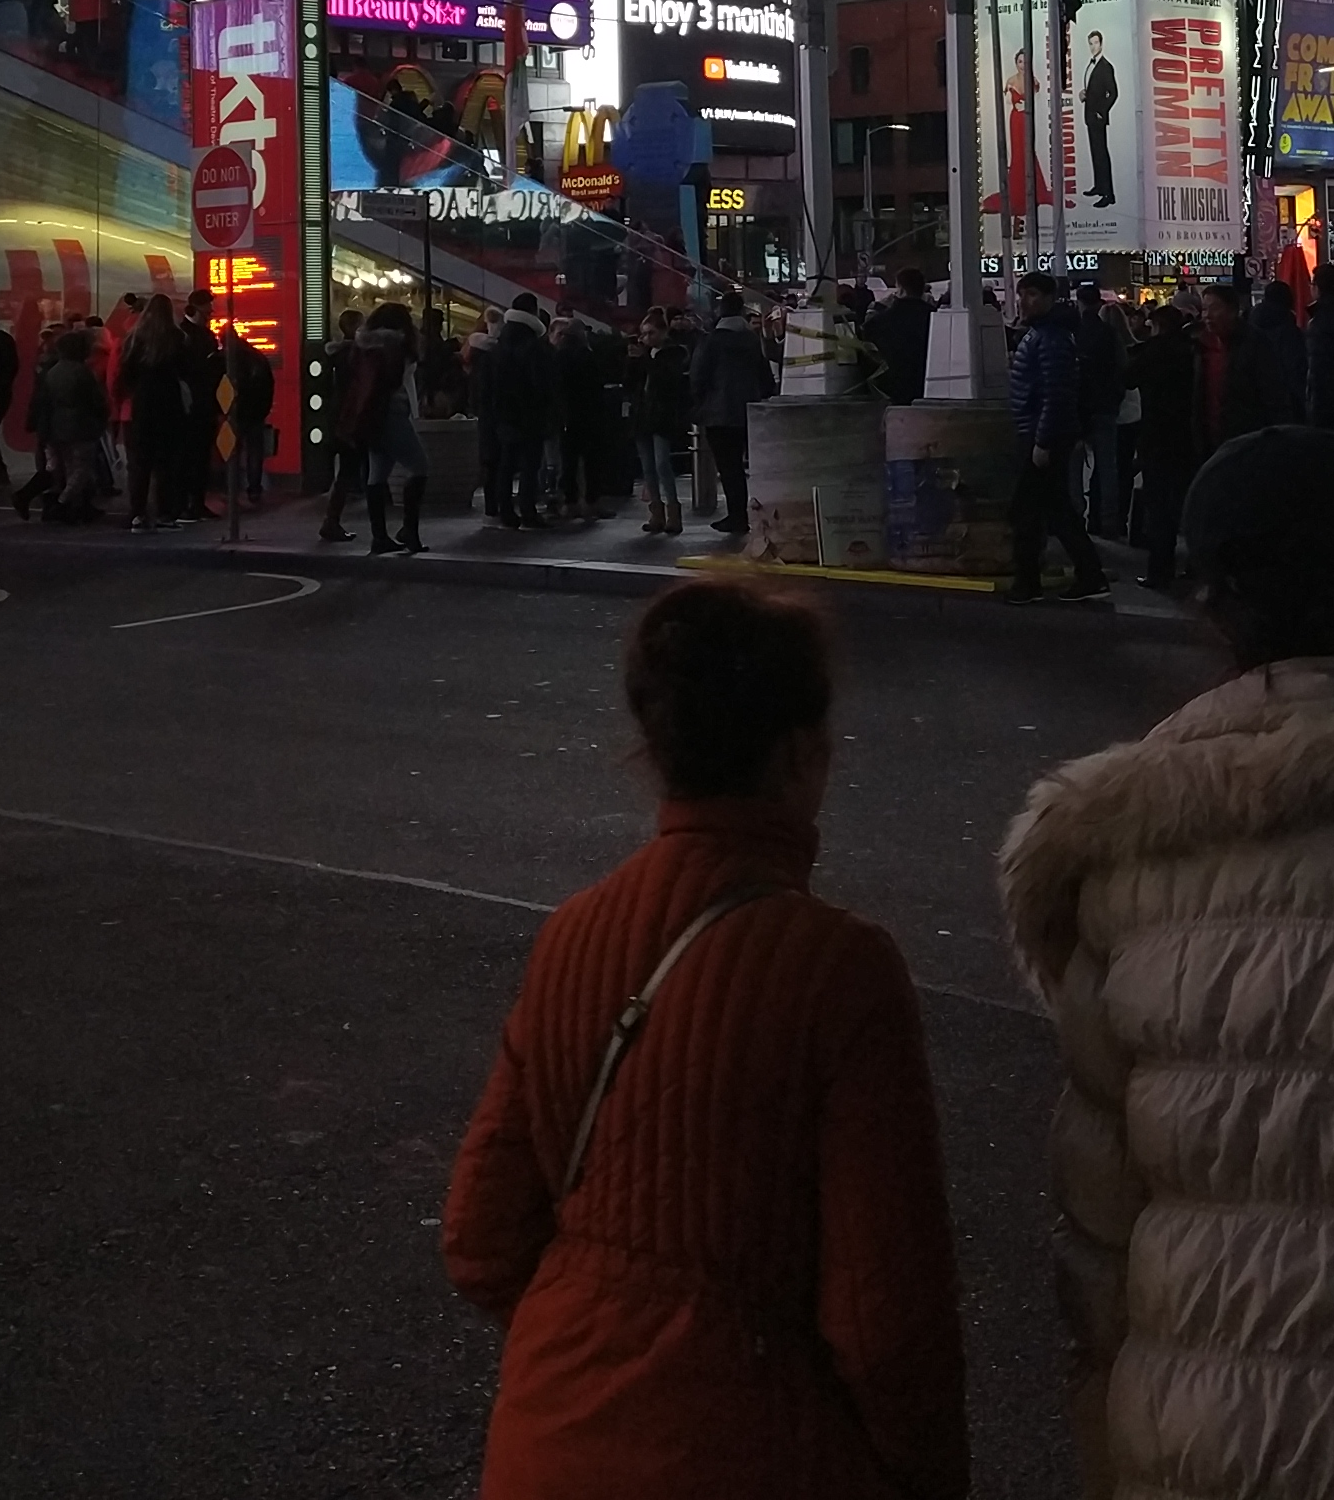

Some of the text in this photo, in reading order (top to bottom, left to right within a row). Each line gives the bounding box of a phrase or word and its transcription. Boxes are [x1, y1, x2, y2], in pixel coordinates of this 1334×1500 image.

[477, 6, 497, 16] with
[717, 4, 785, 39] months
[1151, 18, 1193, 178] WOMAN
[1186, 18, 1230, 185] PRETTY
[202, 166, 241, 184] DO NOT
[561, 174, 620, 189] McDonald's
[1156, 186, 1231, 222] THE MUSICAL
[205, 213, 239, 229] ENTER
[1158, 231, 1233, 241] ON BROADWAY
[1013, 254, 1099, 273] LGGAGE
[1145, 250, 1235, 267] GIFTS LUGGAGE
